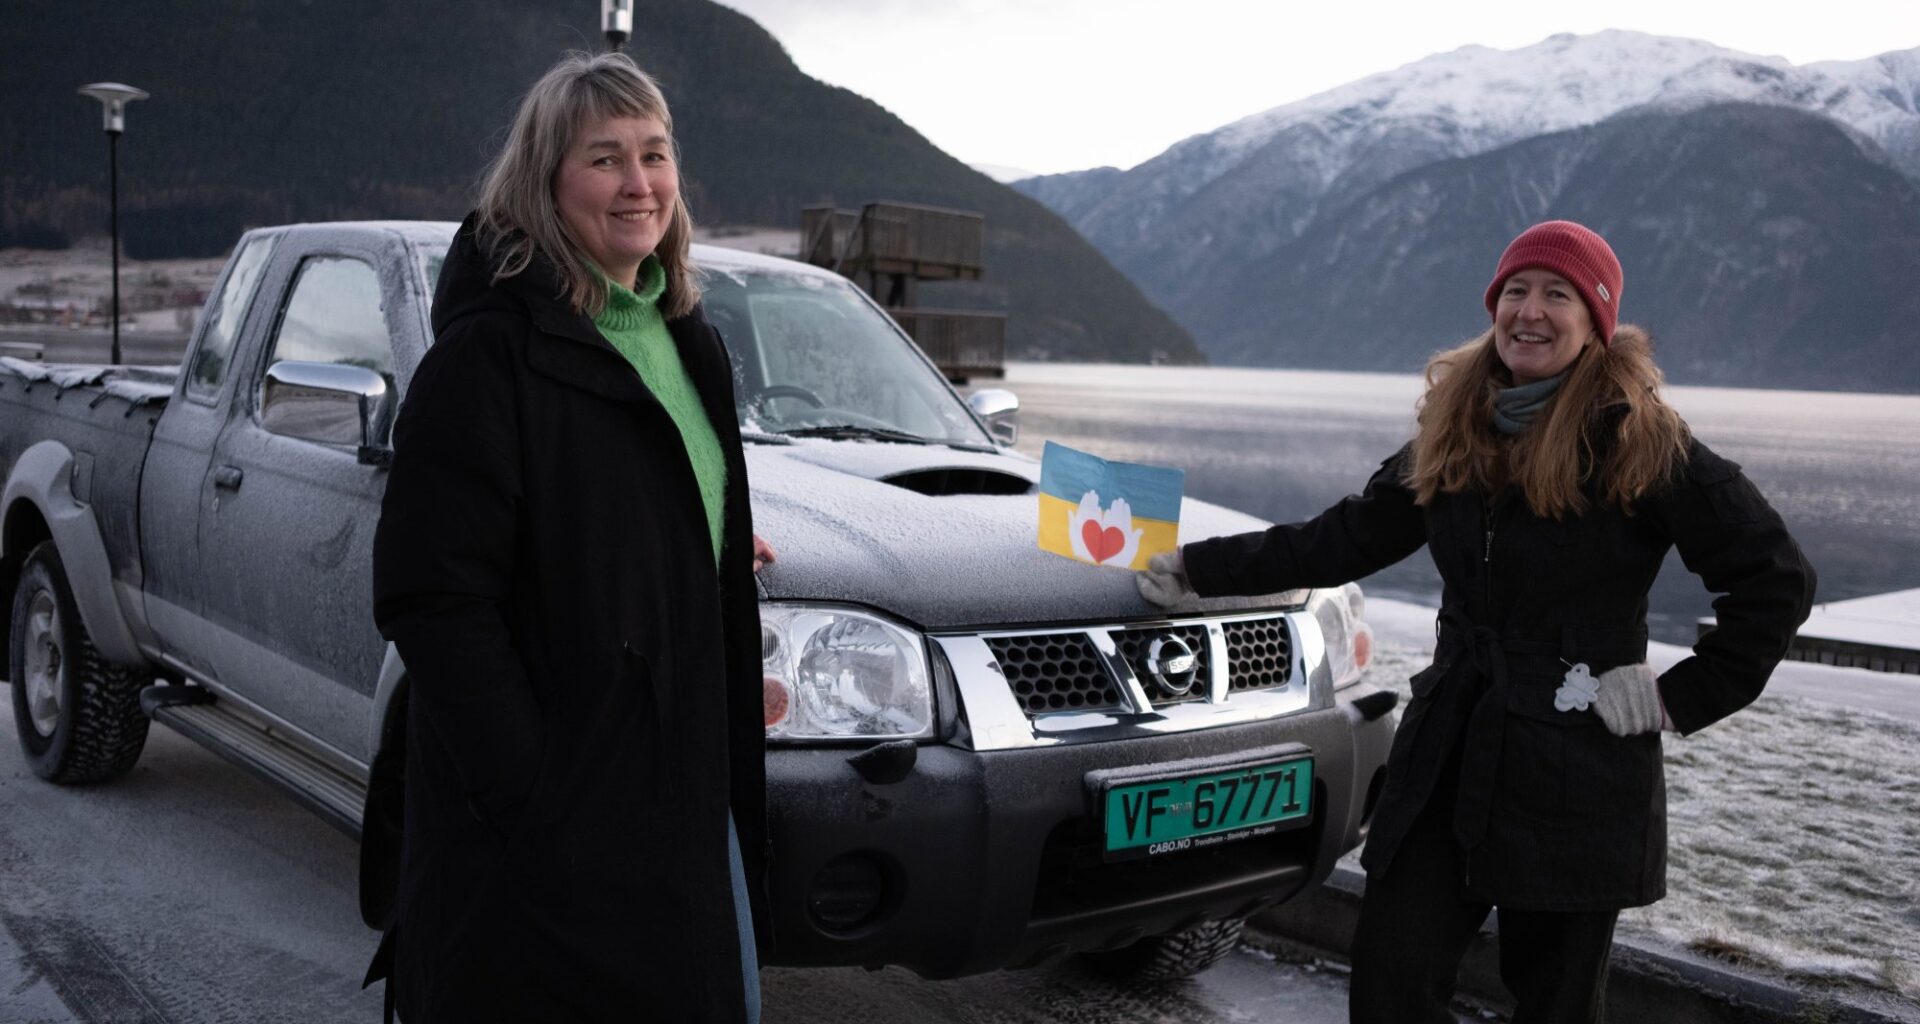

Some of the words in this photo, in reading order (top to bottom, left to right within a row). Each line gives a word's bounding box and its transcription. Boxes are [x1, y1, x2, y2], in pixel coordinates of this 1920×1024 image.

[1123, 789, 1169, 840] VF
[1194, 768, 1300, 829] 67771
[1149, 839, 1190, 854] CABO.NO
